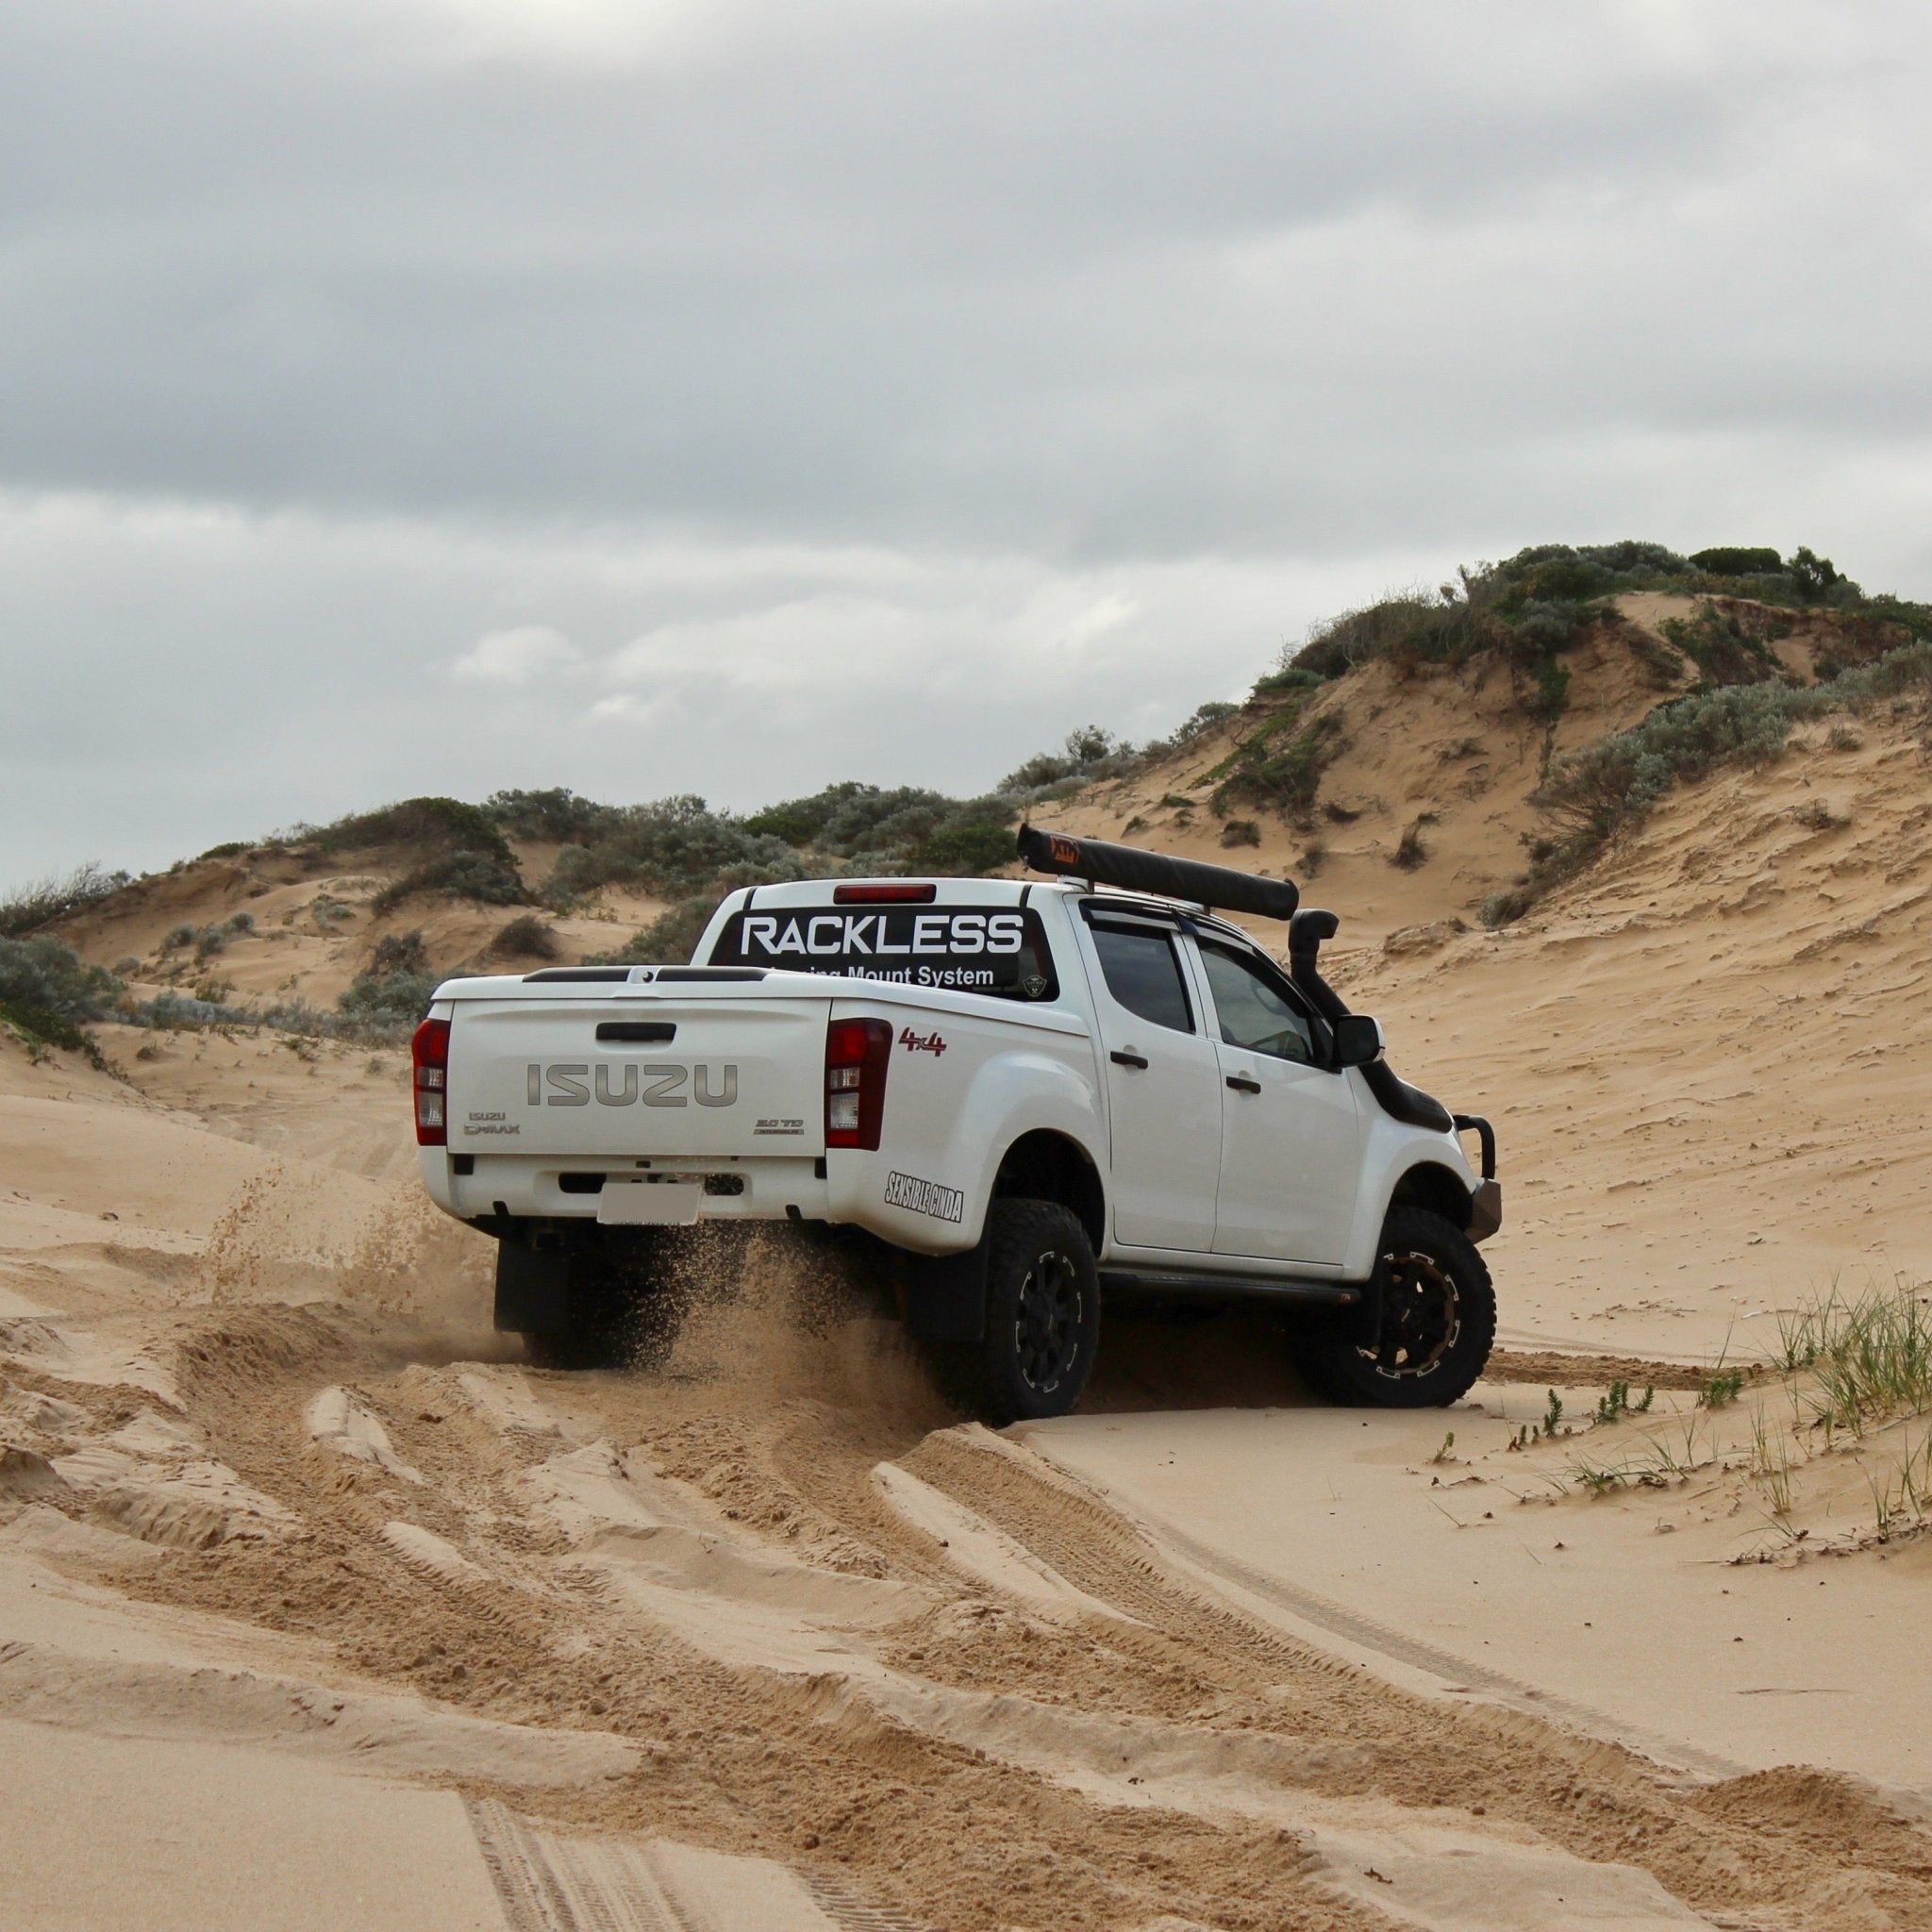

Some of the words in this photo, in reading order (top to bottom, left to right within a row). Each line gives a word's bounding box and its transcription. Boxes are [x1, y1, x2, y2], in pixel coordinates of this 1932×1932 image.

[741, 914, 1024, 955] RACKLESS
[849, 966, 912, 984] Mount
[917, 965, 994, 988] System
[526, 1064, 738, 1107] ISUZU
